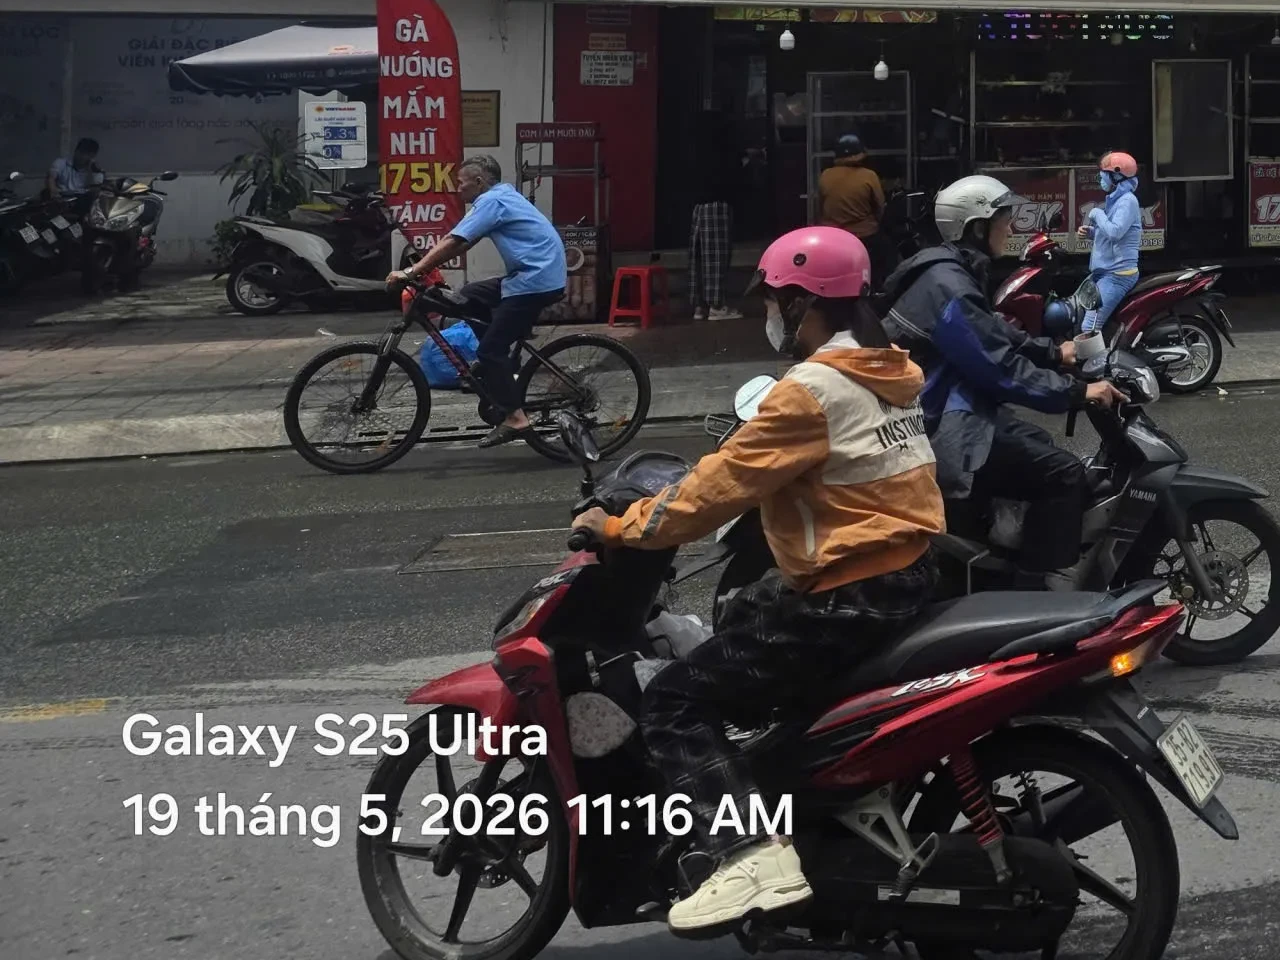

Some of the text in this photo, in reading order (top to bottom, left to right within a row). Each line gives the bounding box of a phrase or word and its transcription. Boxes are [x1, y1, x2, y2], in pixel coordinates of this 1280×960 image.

[395, 14, 429, 43] GÀ
[380, 50, 453, 78] NƯỚNG
[383, 85, 446, 119] MẮM
[390, 127, 437, 156] NHĨ
[379, 162, 457, 194] 175K
[390, 200, 446, 227] TẶNG
[1130, 488, 1157, 502] YAMAHA
[1165, 722, 1199, 767] 35-B2
[1182, 749, 1220, 801] 719.91
